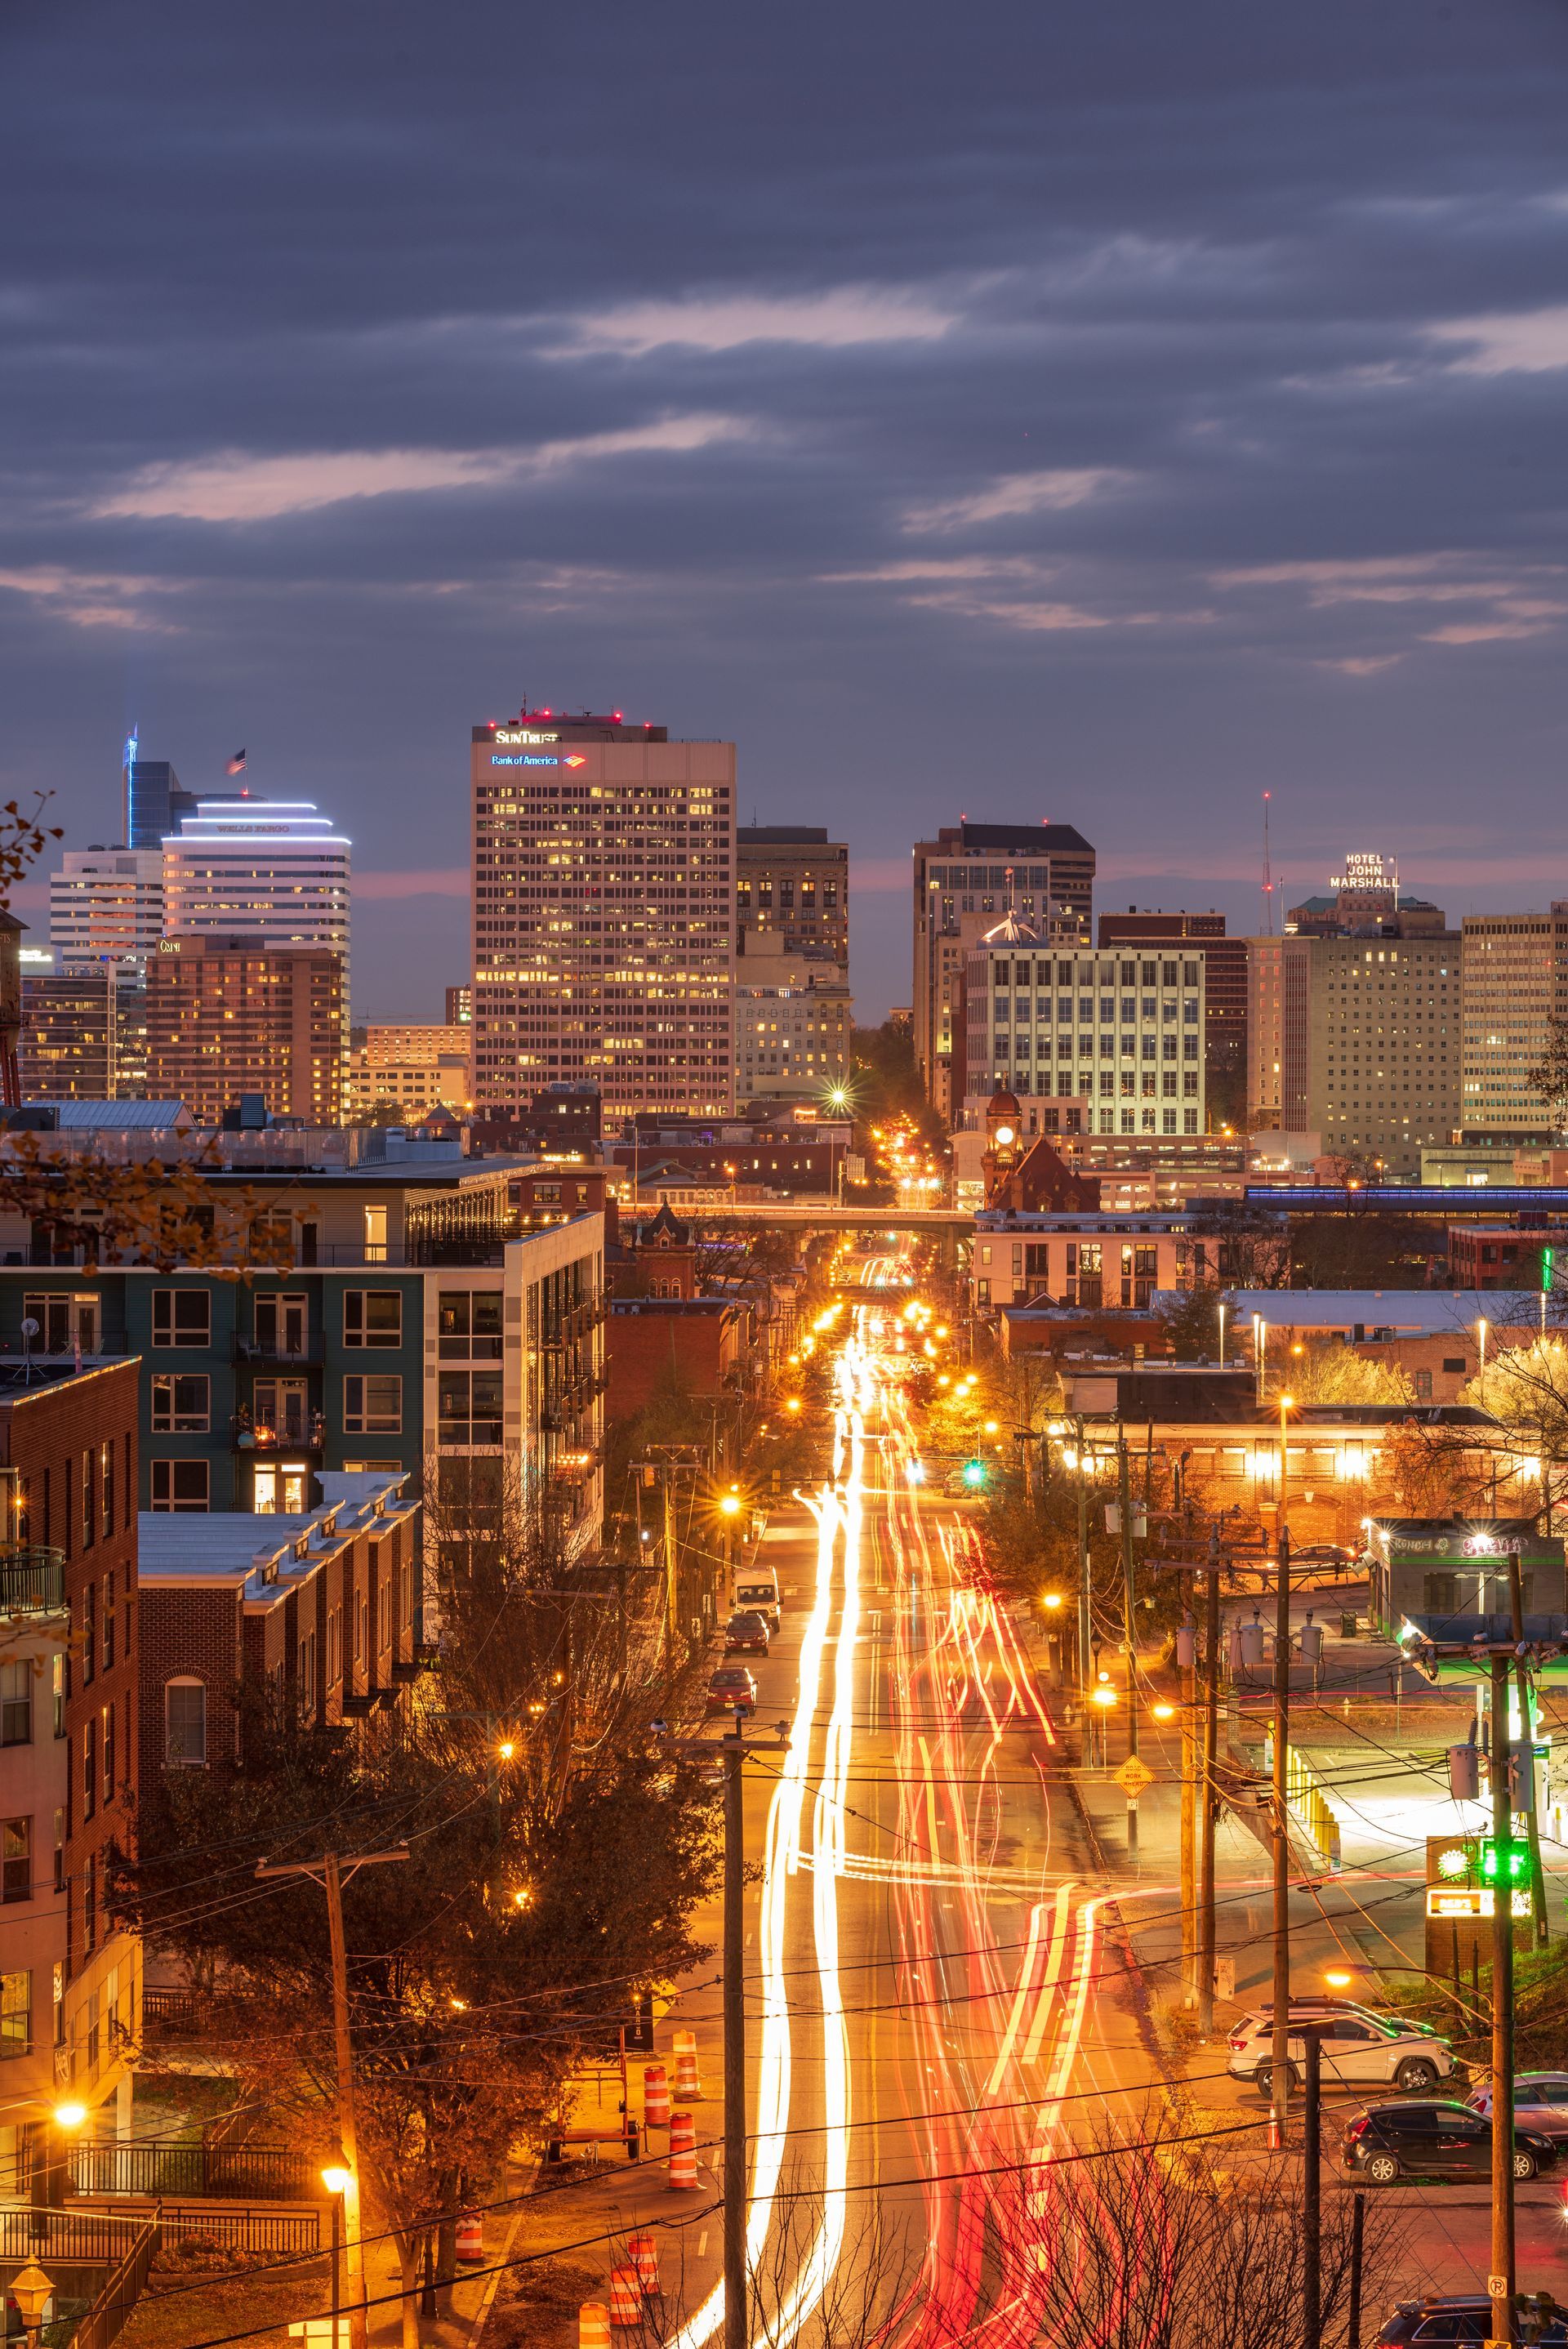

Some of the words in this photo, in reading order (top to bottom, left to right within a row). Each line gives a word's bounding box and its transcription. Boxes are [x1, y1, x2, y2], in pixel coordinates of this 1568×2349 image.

[492, 756, 513, 765] Bank
[514, 756, 523, 765] of
[523, 756, 558, 765] America
[216, 825, 252, 833] WELLS
[255, 825, 290, 833] FARGO
[1347, 854, 1383, 864] HOTEL
[1348, 866, 1383, 876] JOHN
[1330, 876, 1401, 888] MARSHALL
